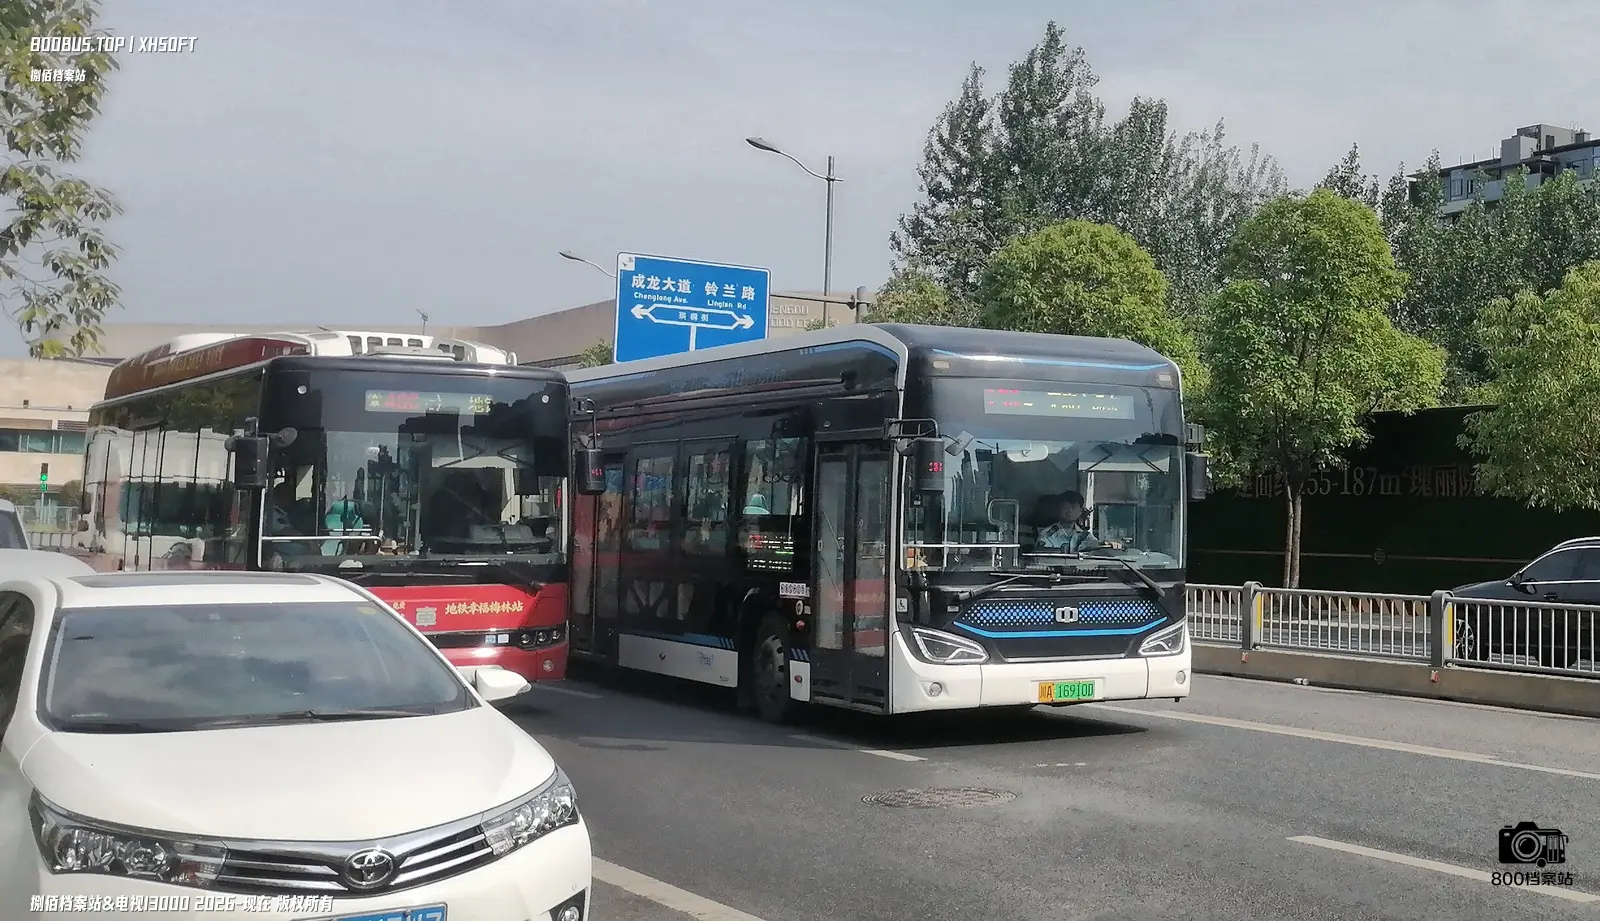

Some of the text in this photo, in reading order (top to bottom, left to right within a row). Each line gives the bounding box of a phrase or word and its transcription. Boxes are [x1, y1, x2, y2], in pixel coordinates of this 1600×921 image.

[631, 273, 756, 301] 成龙大道 铃兰路
[633, 291, 672, 303] Chenglong
